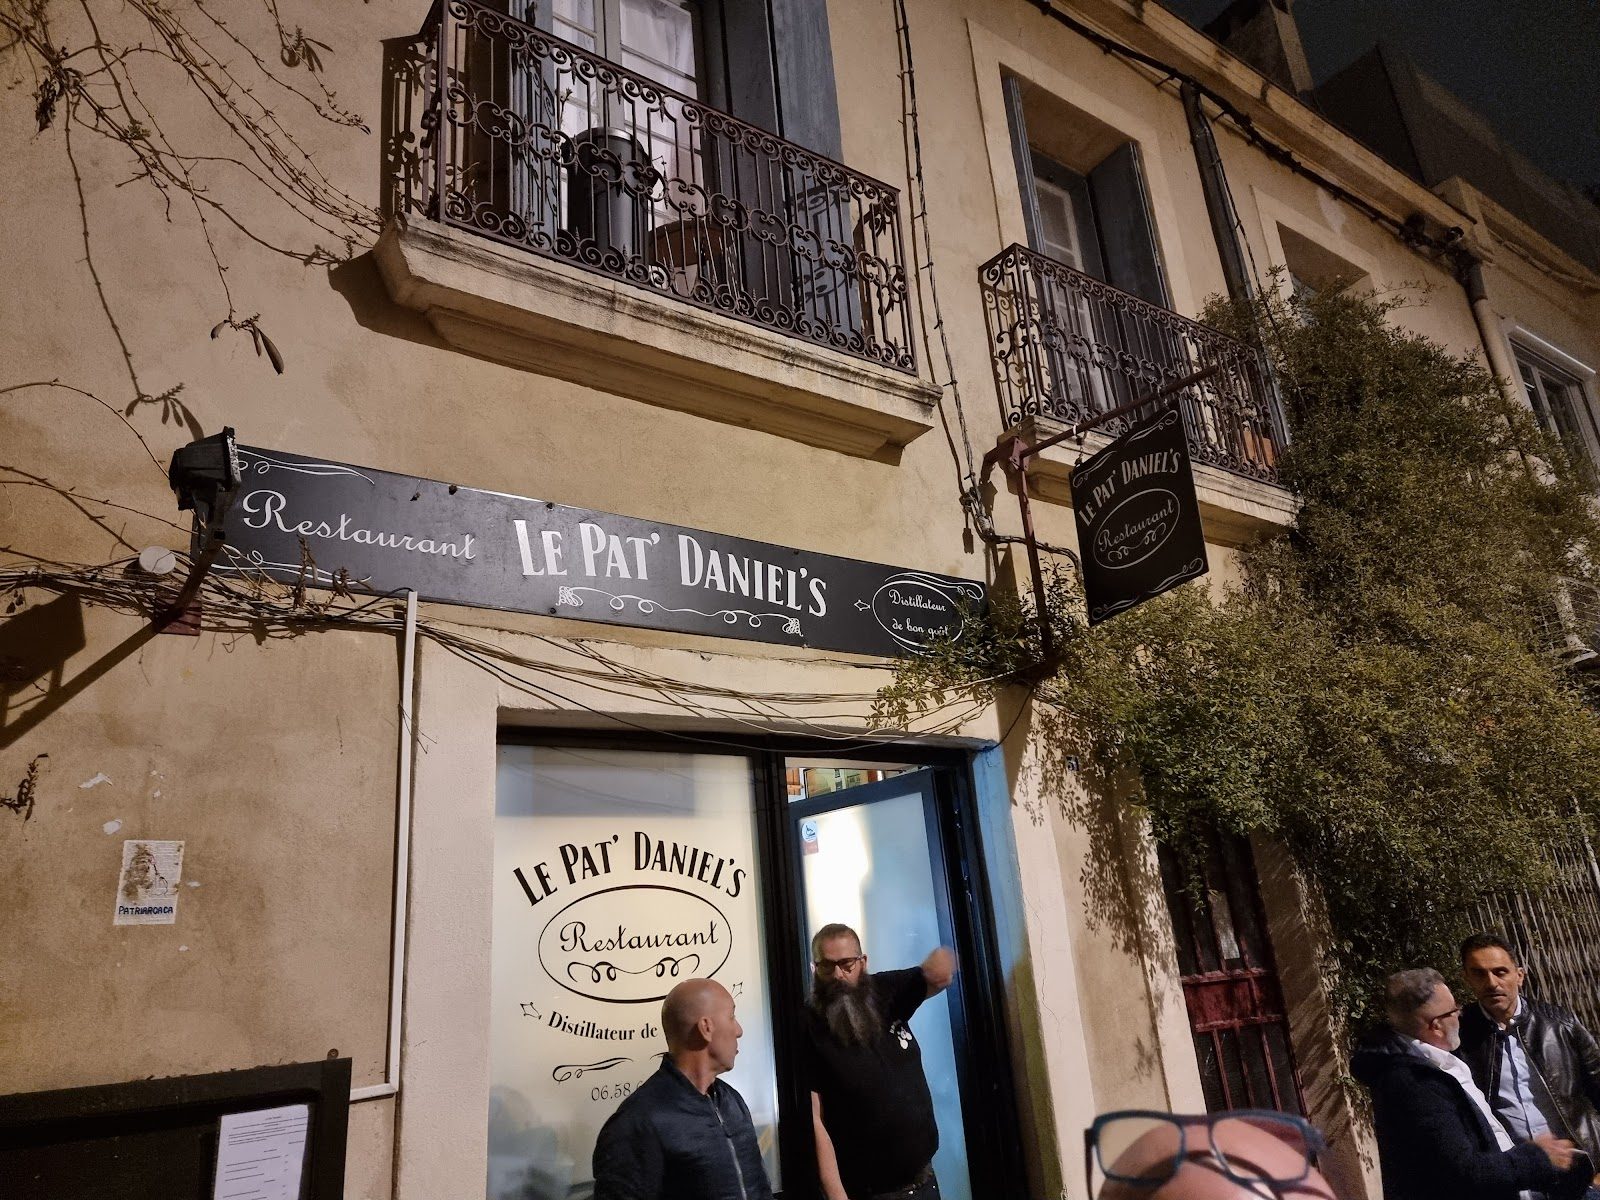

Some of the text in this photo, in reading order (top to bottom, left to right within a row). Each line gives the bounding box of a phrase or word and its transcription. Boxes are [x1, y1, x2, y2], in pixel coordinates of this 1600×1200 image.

[1079, 501, 1097, 527] LE
[1122, 449, 1180, 484] DANIEL'S
[242, 489, 476, 560] Restaurant
[1099, 500, 1174, 551] Restaurant
[513, 519, 827, 617] LE PAT' DANIEL'S
[888, 589, 946, 611] Distillateur
[892, 617, 904, 631] de
[906, 617, 925, 633] bon
[512, 831, 747, 907] LE PAT' DANIEL'S
[559, 920, 719, 952] Restaurant
[549, 1011, 658, 1040] Distillateur de
